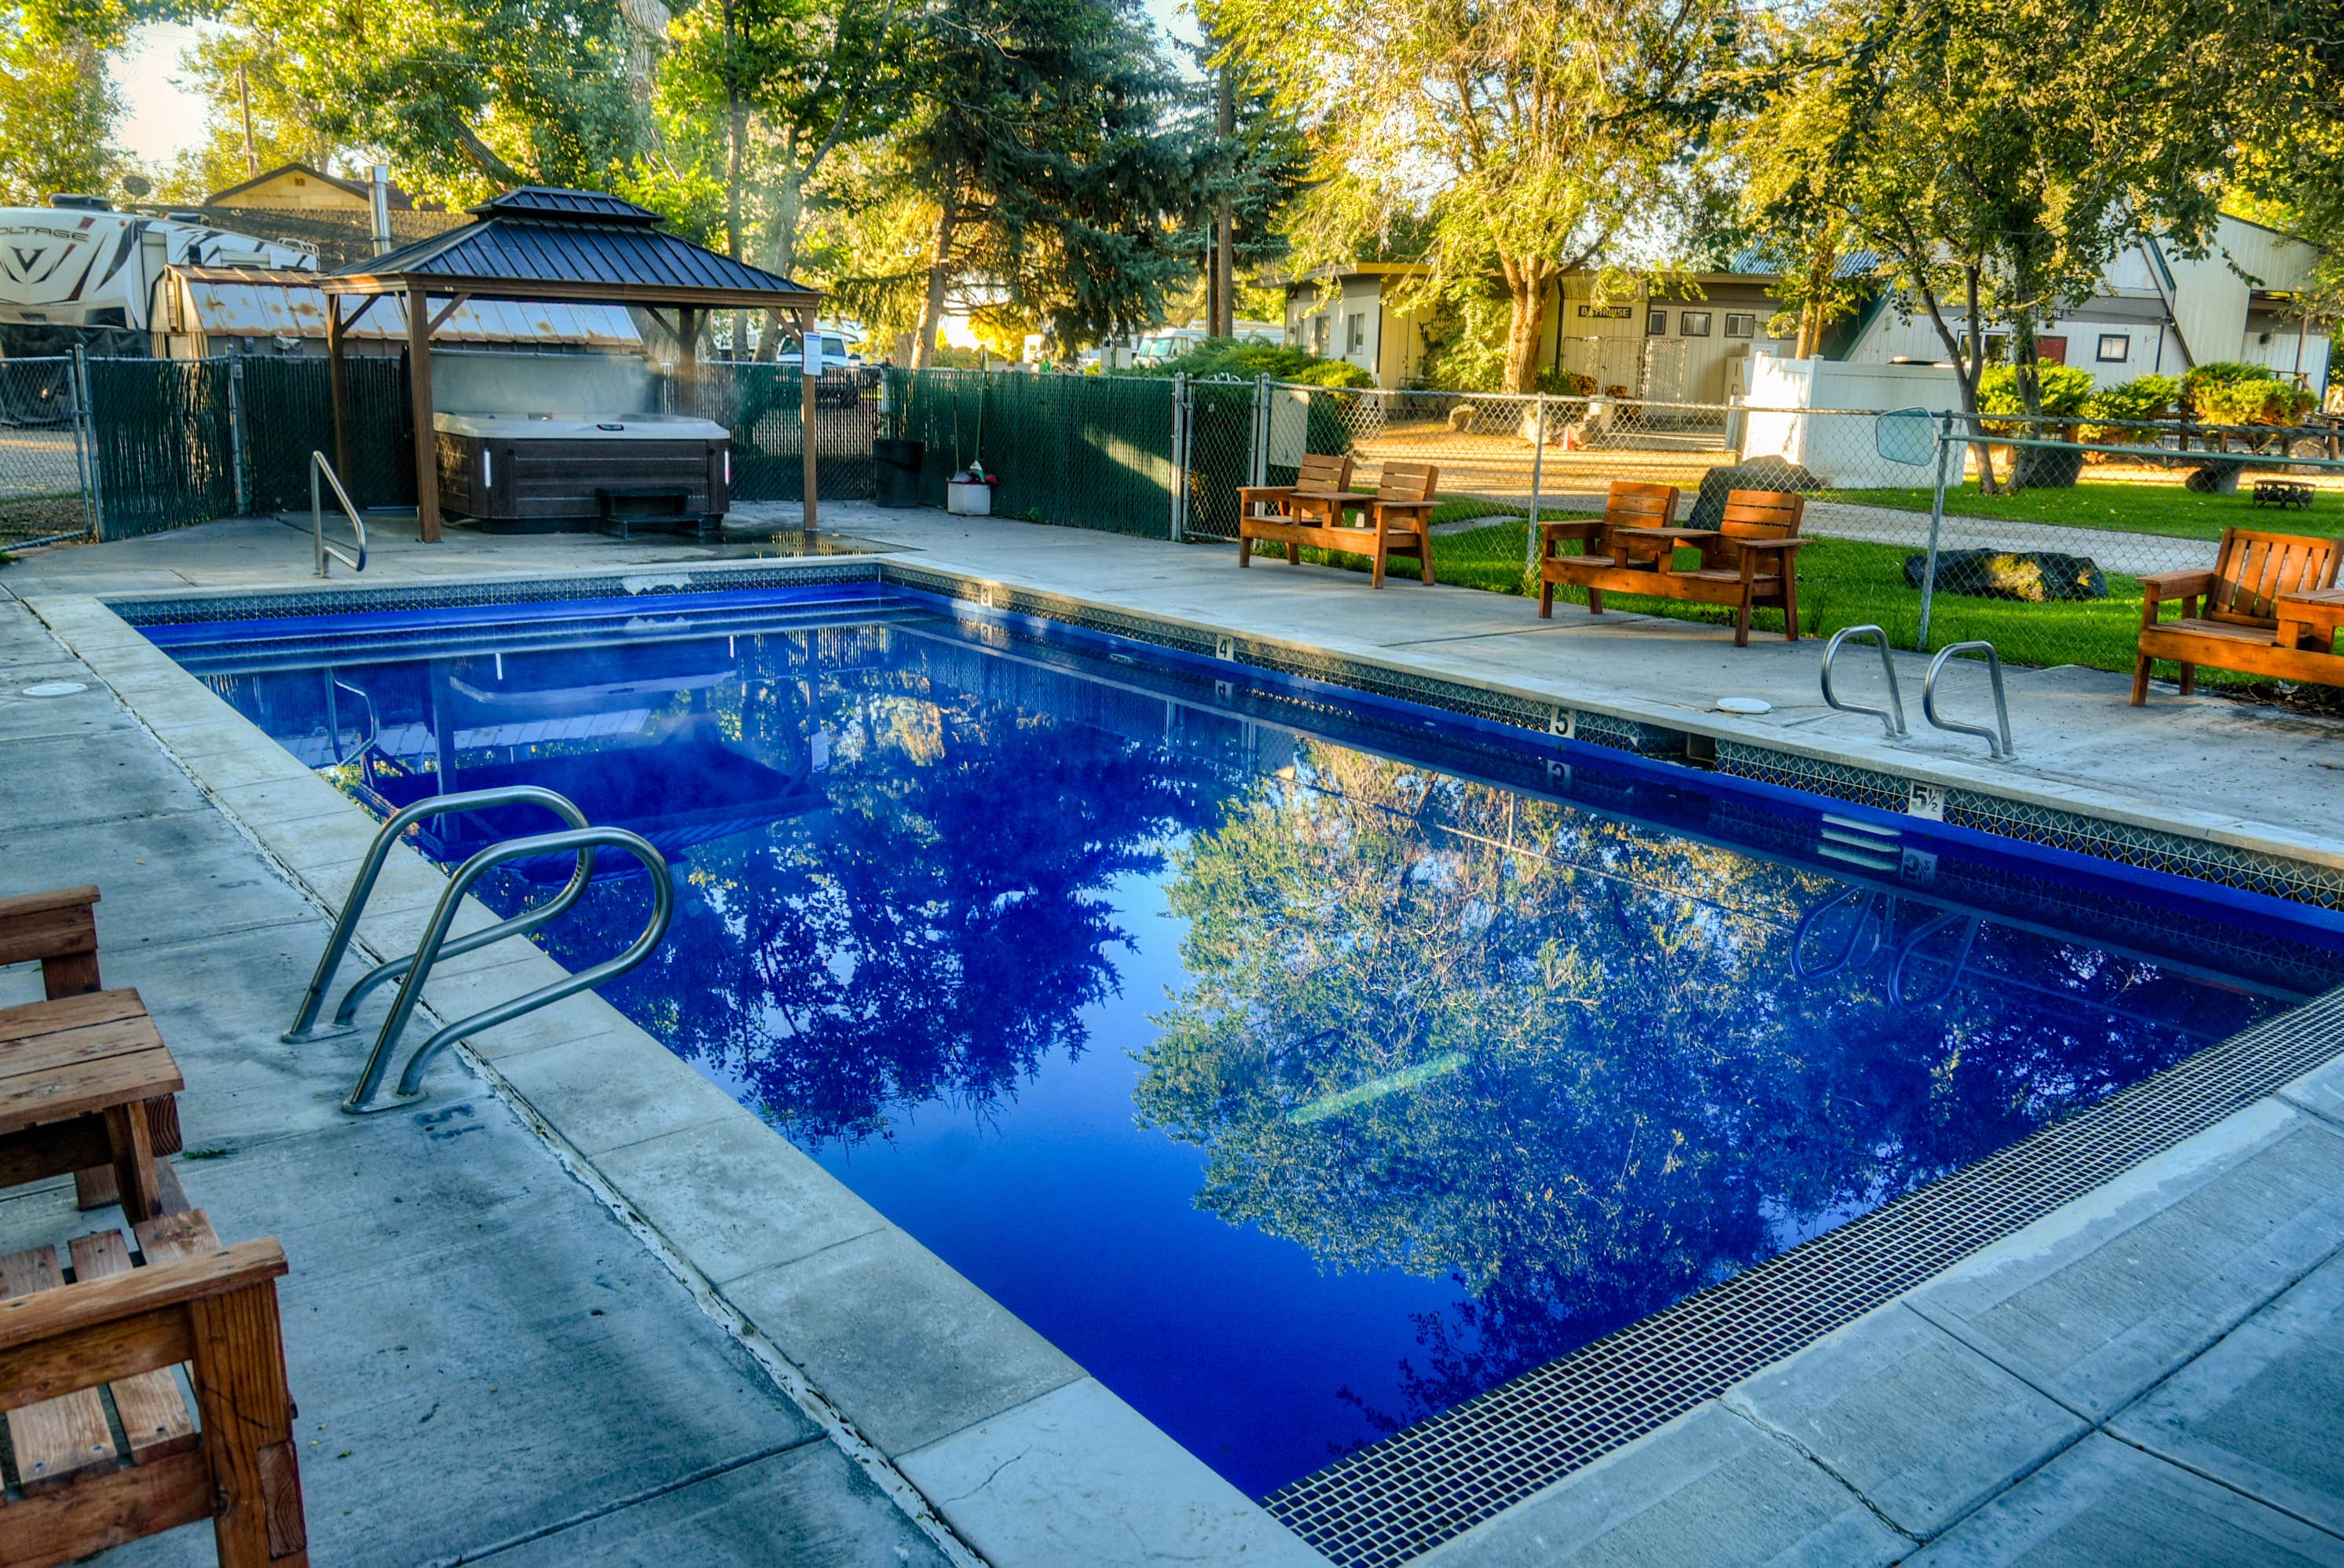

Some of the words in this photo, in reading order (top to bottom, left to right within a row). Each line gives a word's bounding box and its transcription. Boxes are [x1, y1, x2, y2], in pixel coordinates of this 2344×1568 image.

[0, 225, 89, 243] OLTAGE
[9, 245, 49, 274] V
[2038, 308, 2063, 318] SORE
[1555, 707, 1569, 735] 5
